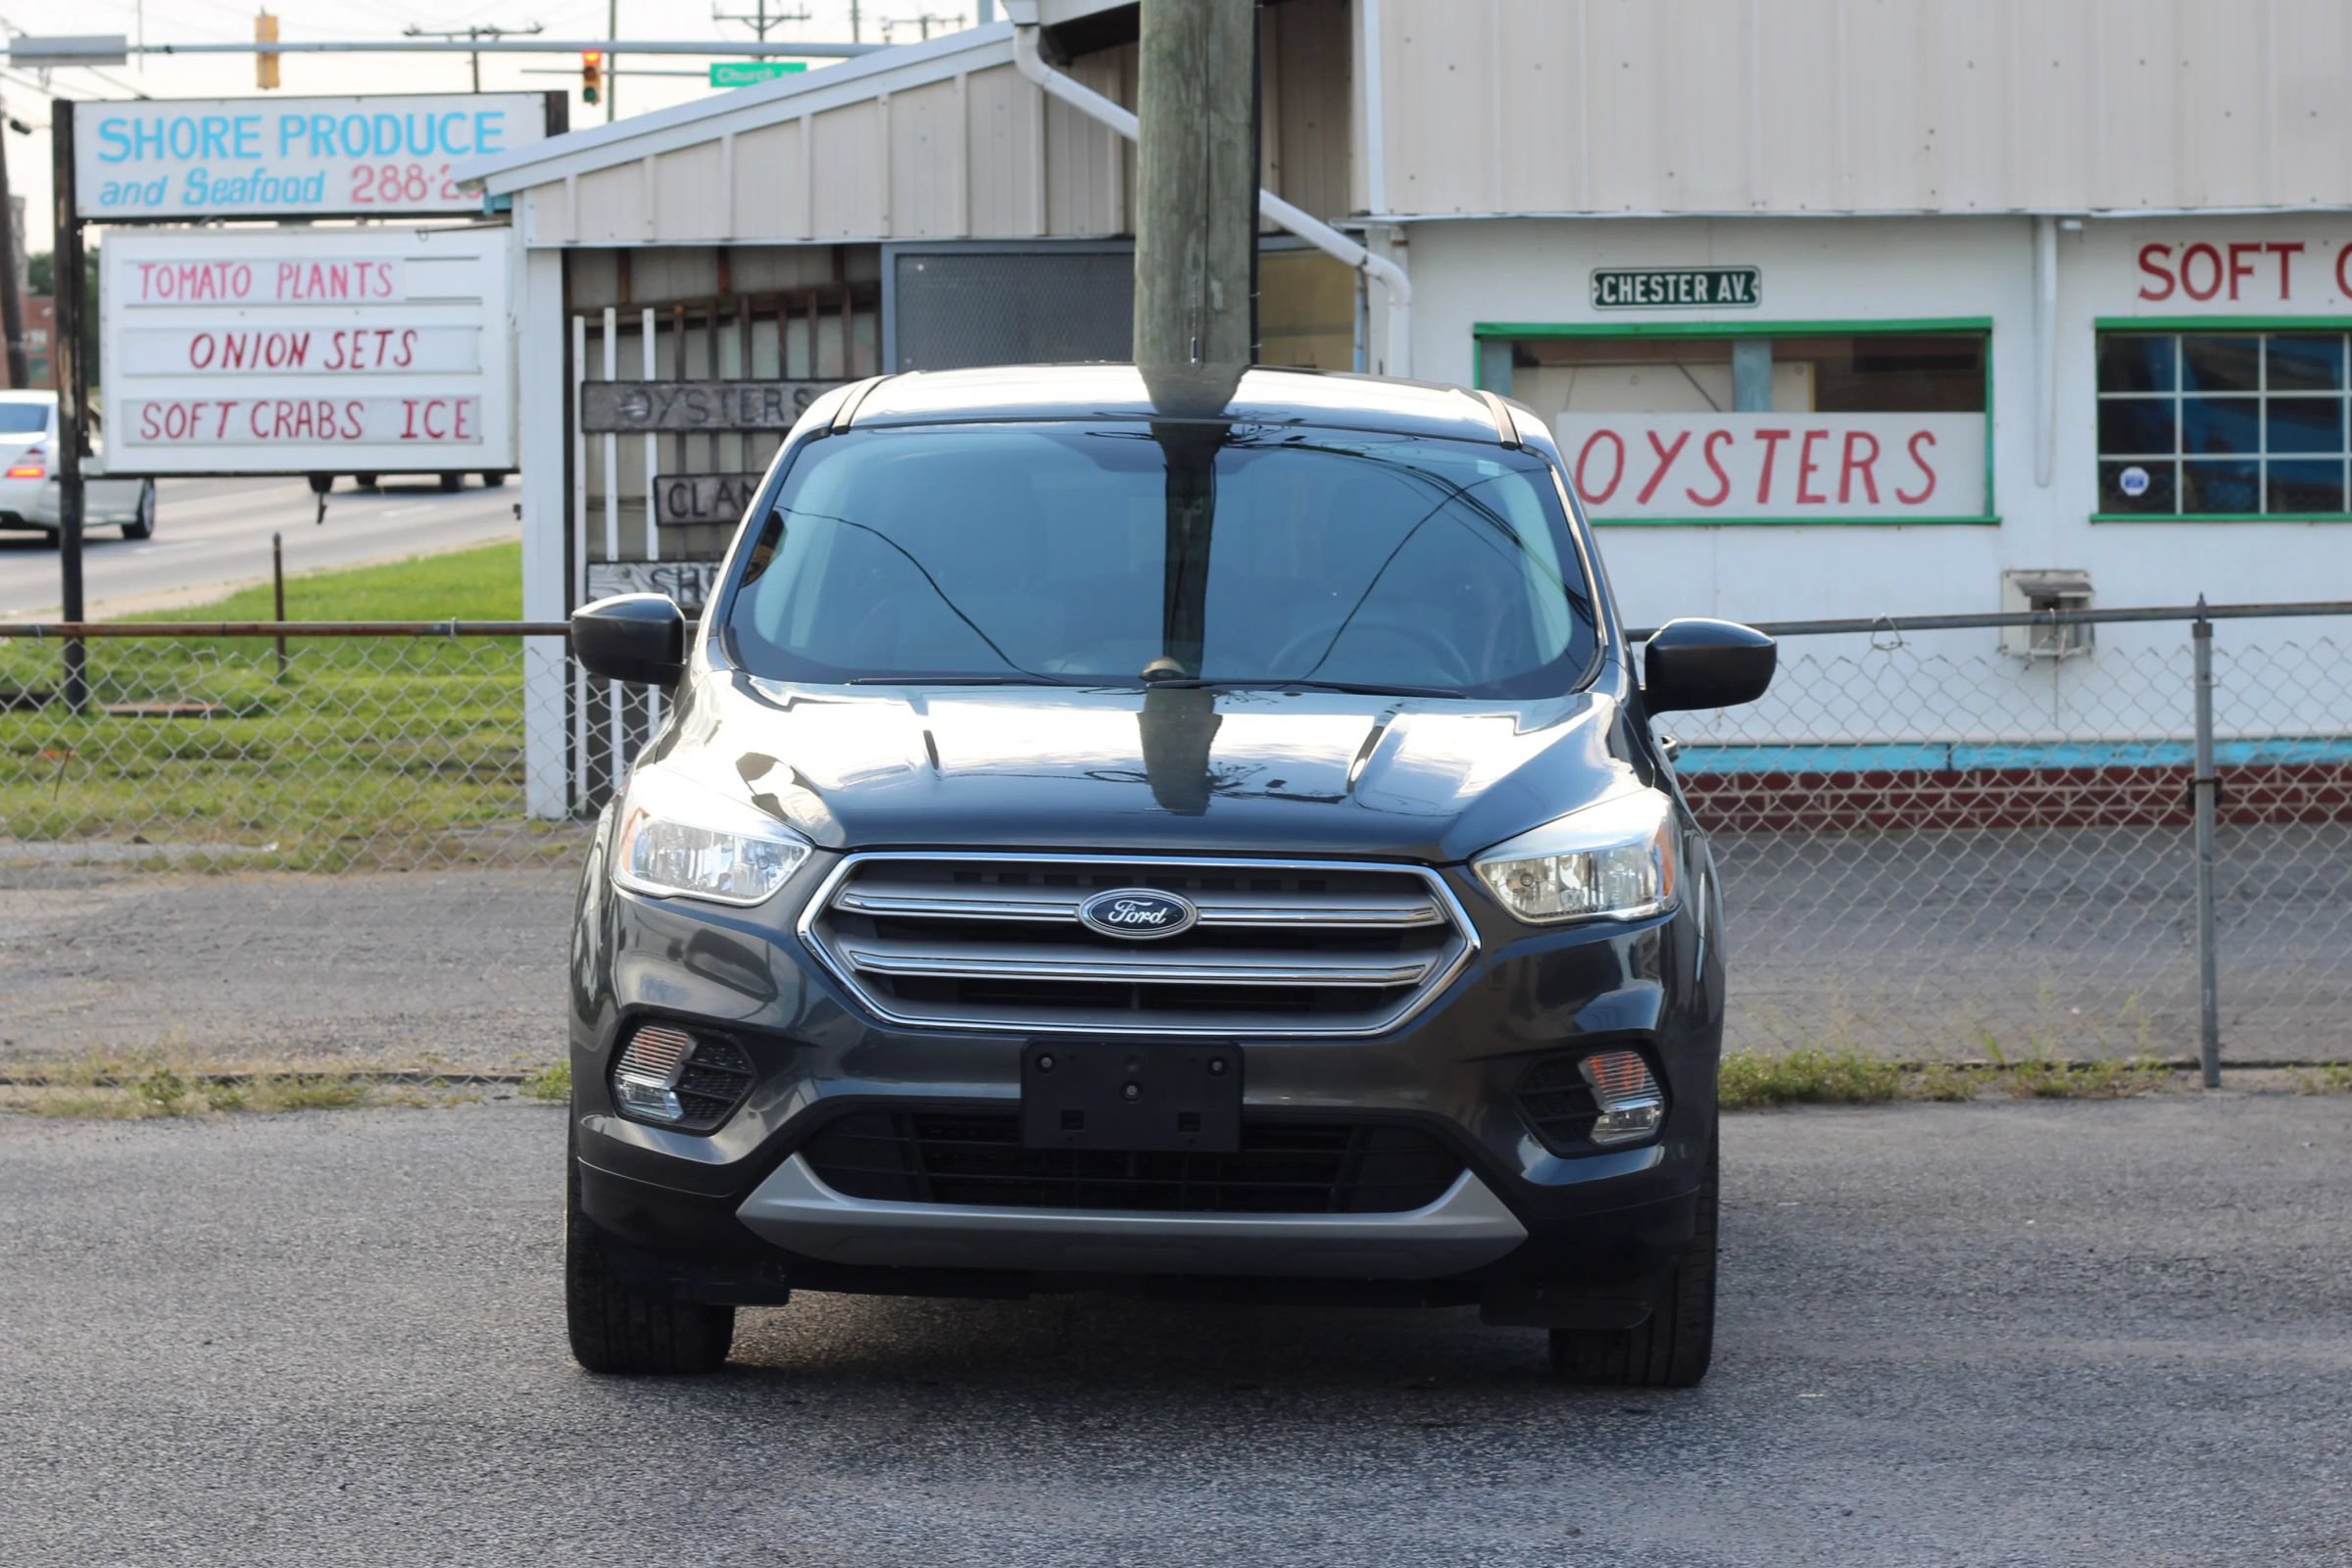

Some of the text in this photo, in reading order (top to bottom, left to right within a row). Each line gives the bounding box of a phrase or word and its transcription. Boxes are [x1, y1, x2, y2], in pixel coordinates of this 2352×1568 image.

[98, 111, 506, 163] SHORE PRODUCE
[99, 174, 169, 207] and
[182, 166, 326, 206] Seafood
[138, 261, 393, 301] TOMATO PLANTS
[1601, 273, 1749, 304] CHESTER AV.
[2137, 241, 2305, 302] SOFT
[189, 328, 418, 370] ONION SETS
[140, 399, 471, 440] SOFT CRABS ICE
[619, 386, 812, 425] OYSTERS
[1575, 428, 1936, 508] OYSTERS
[1107, 899, 1168, 925] Ford
